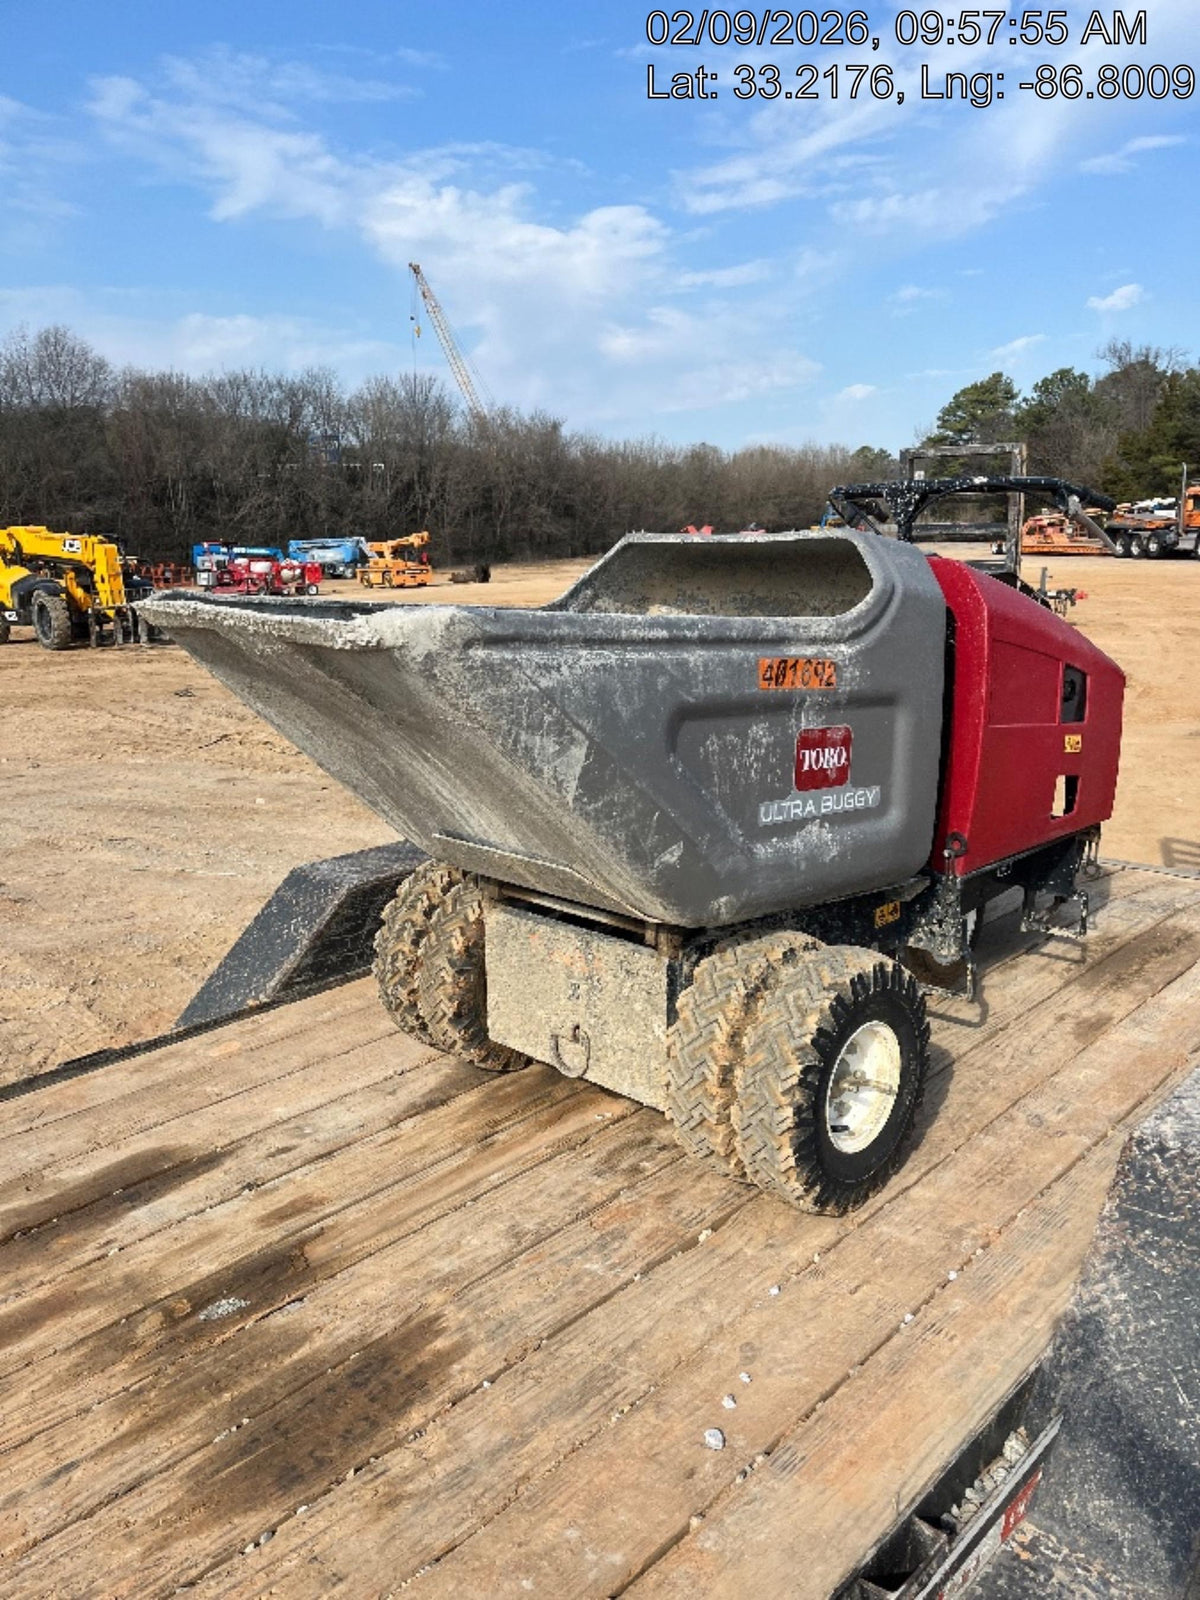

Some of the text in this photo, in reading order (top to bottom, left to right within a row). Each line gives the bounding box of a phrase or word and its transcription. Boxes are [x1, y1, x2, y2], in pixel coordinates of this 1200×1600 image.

[800, 746, 847, 772] TORO
[759, 789, 877, 823] ULTRA BUGGY
